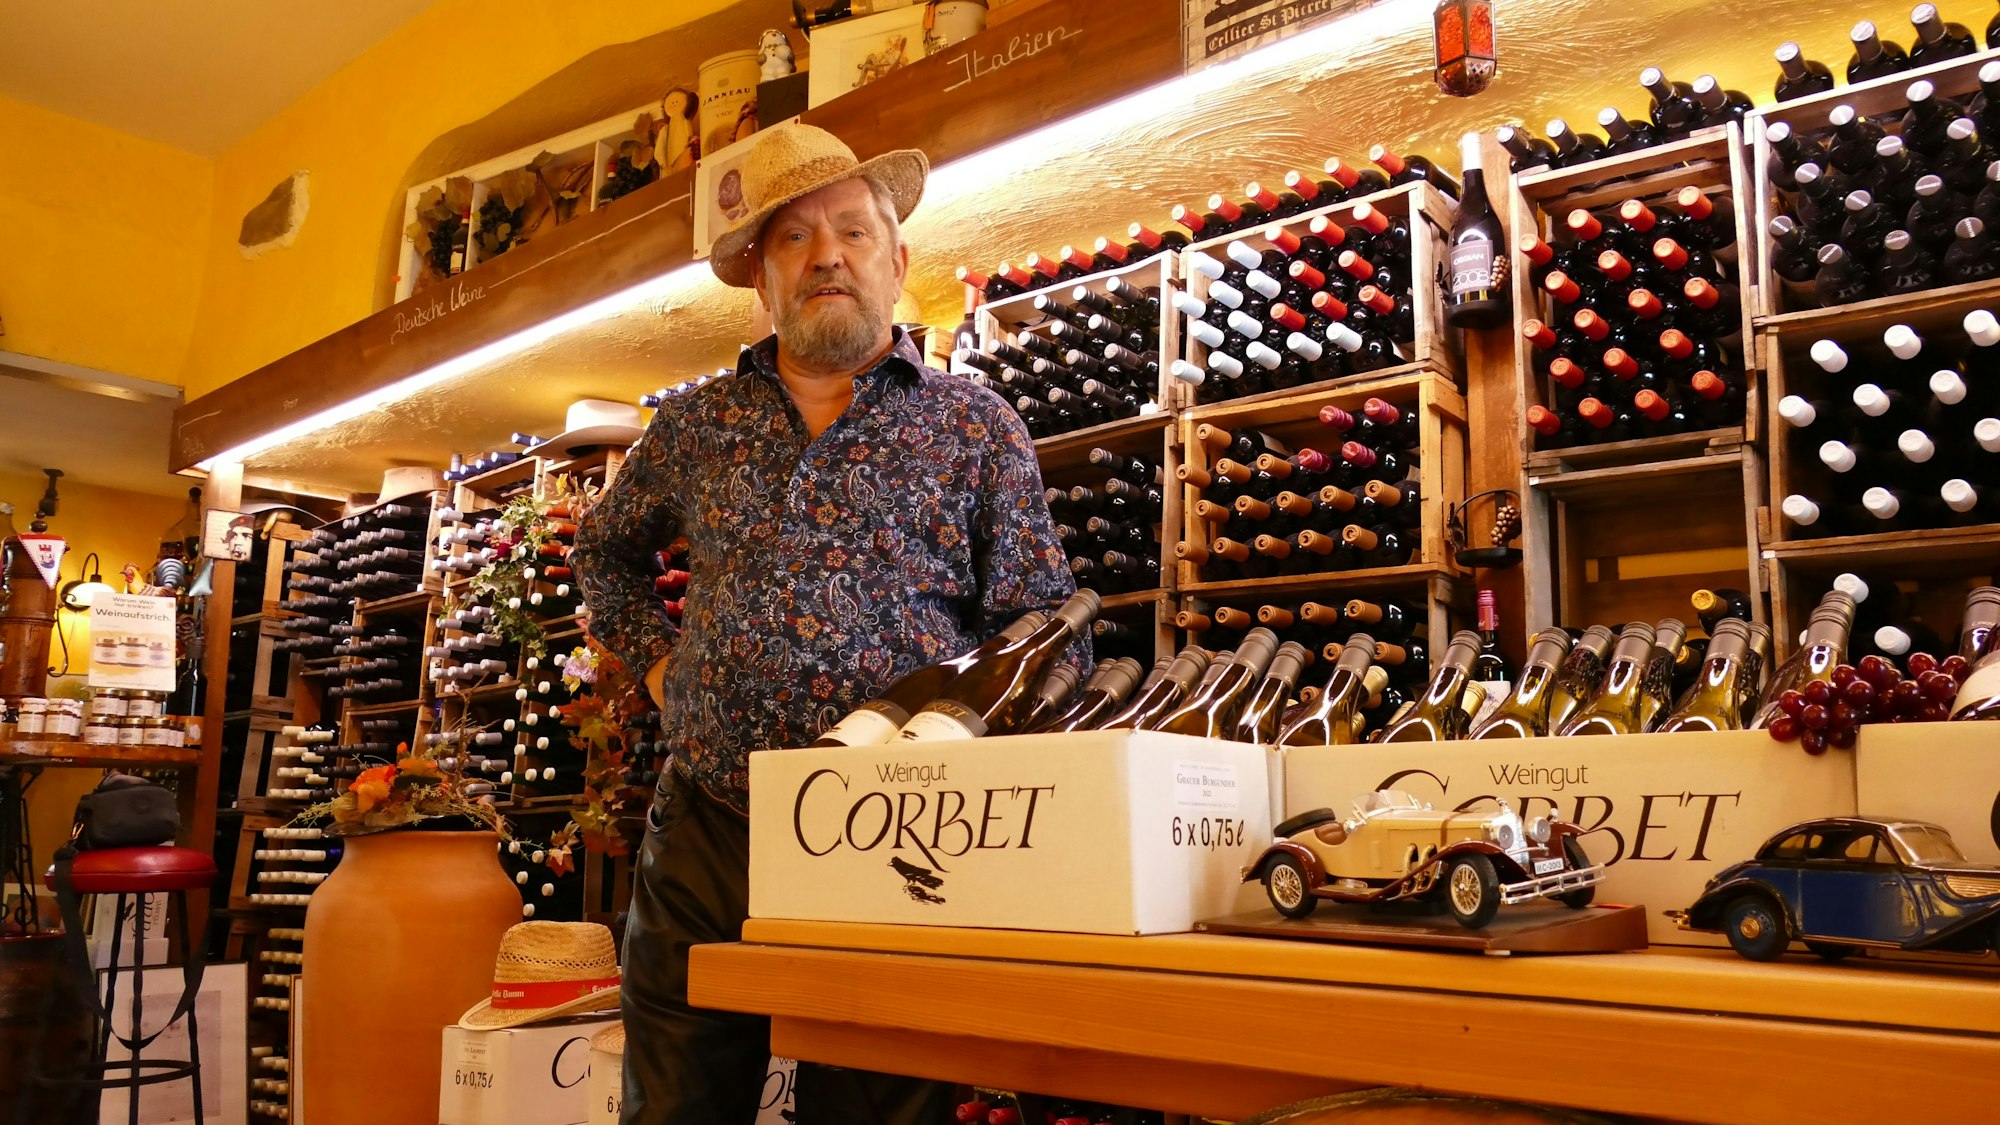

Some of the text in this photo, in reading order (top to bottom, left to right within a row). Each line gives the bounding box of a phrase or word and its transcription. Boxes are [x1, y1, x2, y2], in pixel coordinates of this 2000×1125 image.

[1208, 0, 1328, 52] Cellier St Pierre
[702, 87, 751, 106] JANNEAU
[450, 280, 486, 312] Weine
[112, 596, 137, 604] Warum
[875, 762, 948, 788] Weingut
[1488, 763, 1589, 792] Weingut
[793, 769, 1056, 873] CORBET
[1172, 816, 1182, 846] 6
[1187, 823, 1196, 846] x
[455, 1069, 461, 1085] 6
[463, 1073, 468, 1085] x
[607, 1095, 614, 1114] 6
